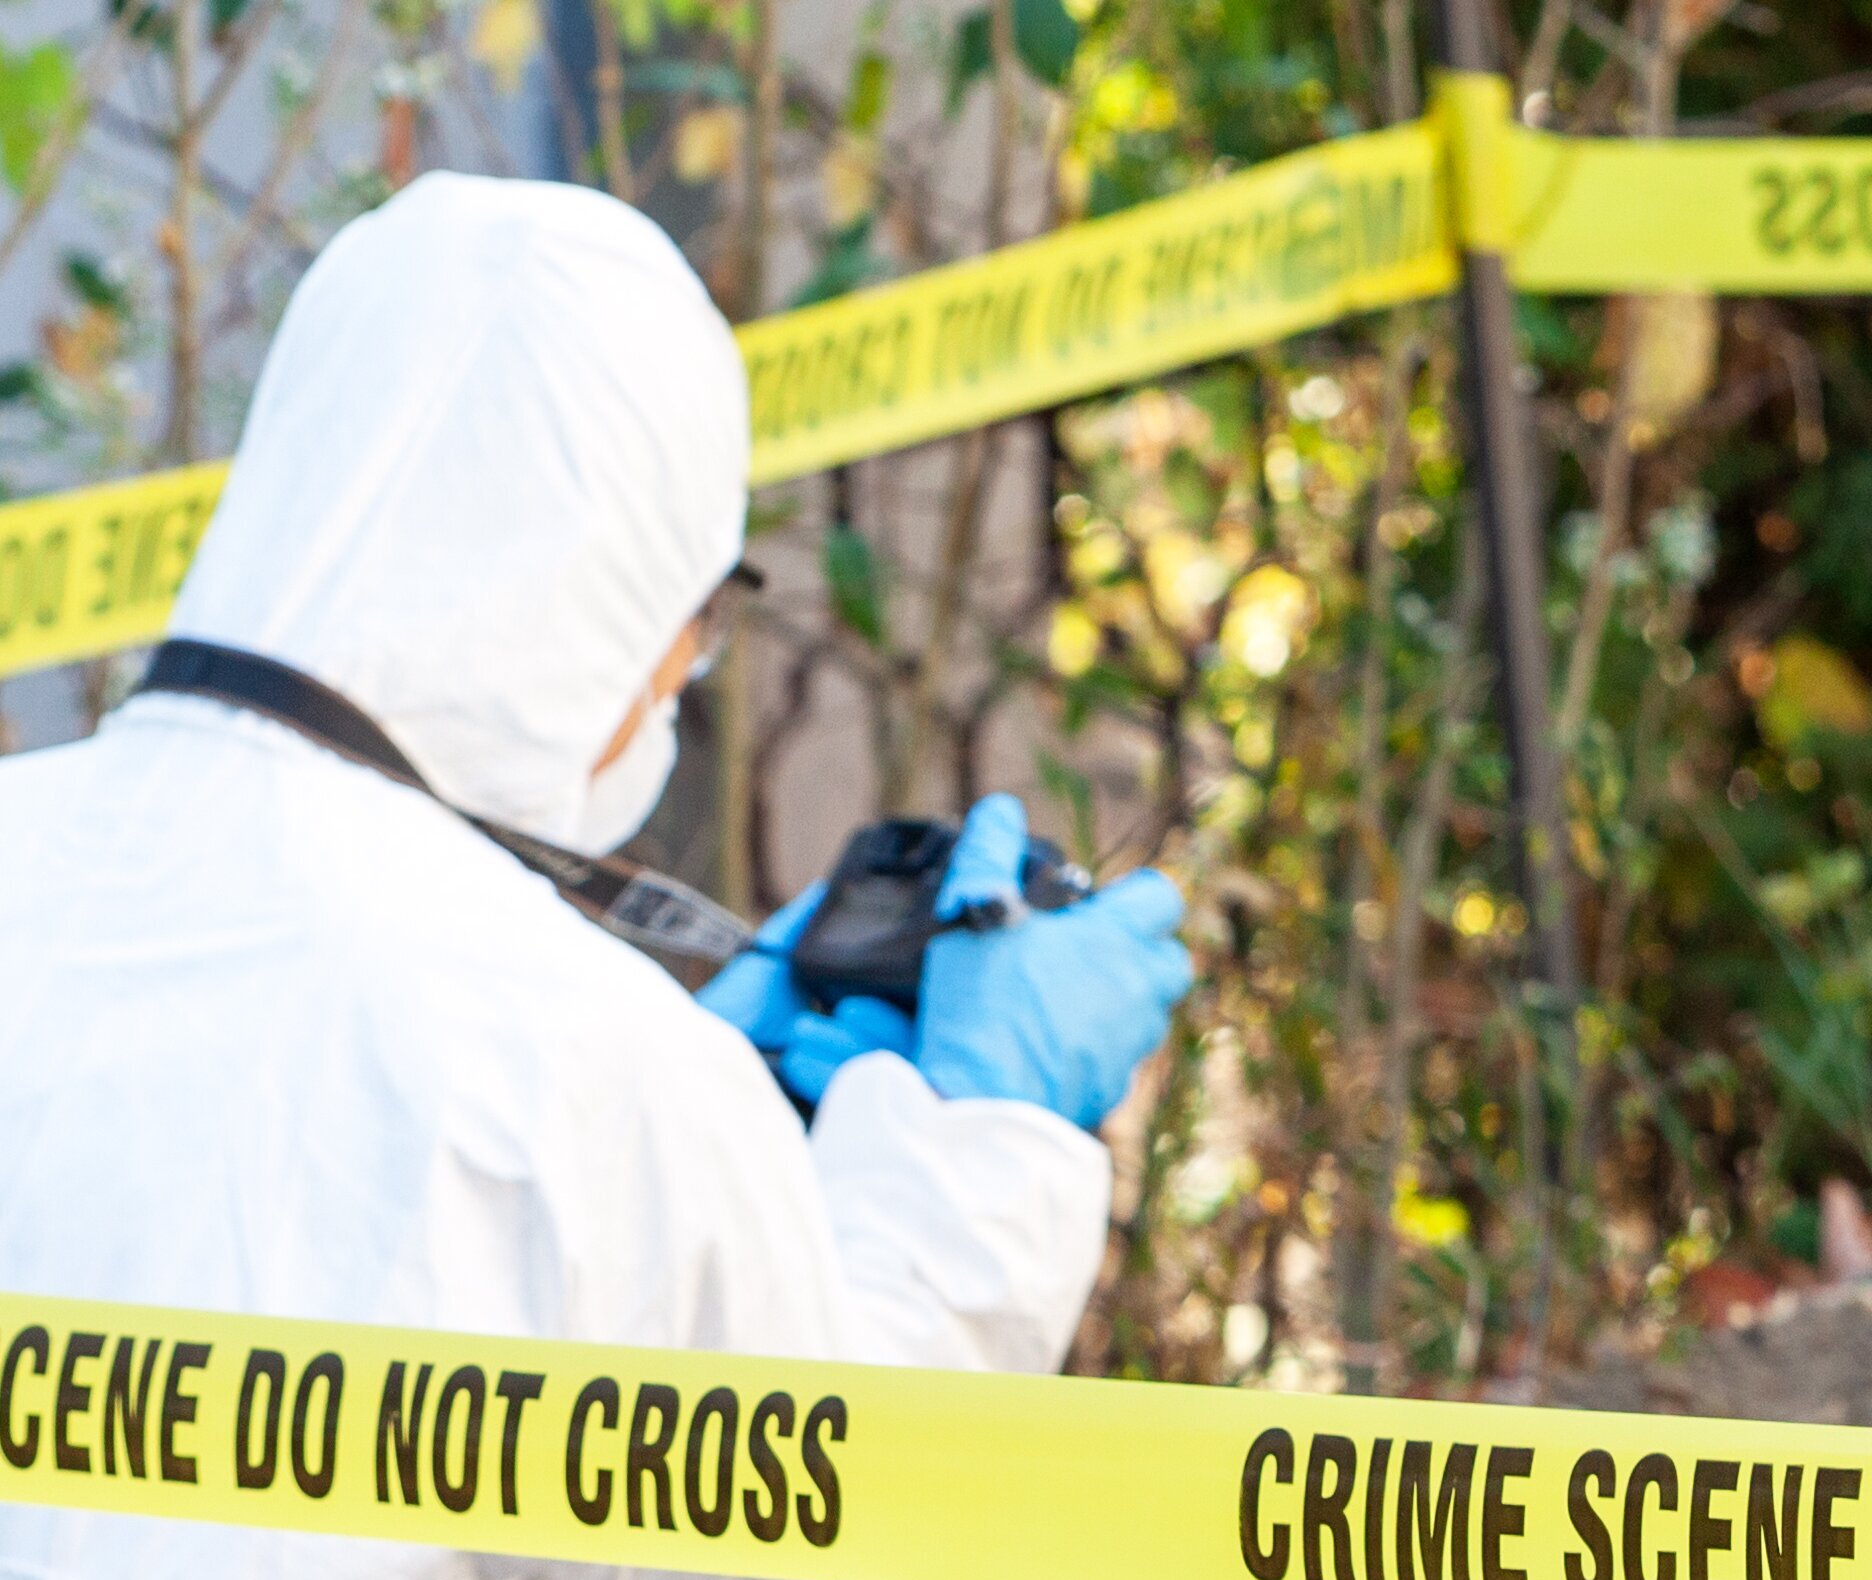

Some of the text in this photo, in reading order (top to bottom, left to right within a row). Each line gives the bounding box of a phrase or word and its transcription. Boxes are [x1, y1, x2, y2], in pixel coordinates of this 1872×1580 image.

[235, 1348, 345, 1500] DO
[375, 1360, 546, 1517] NOT
[565, 1376, 848, 1549] CROSS
